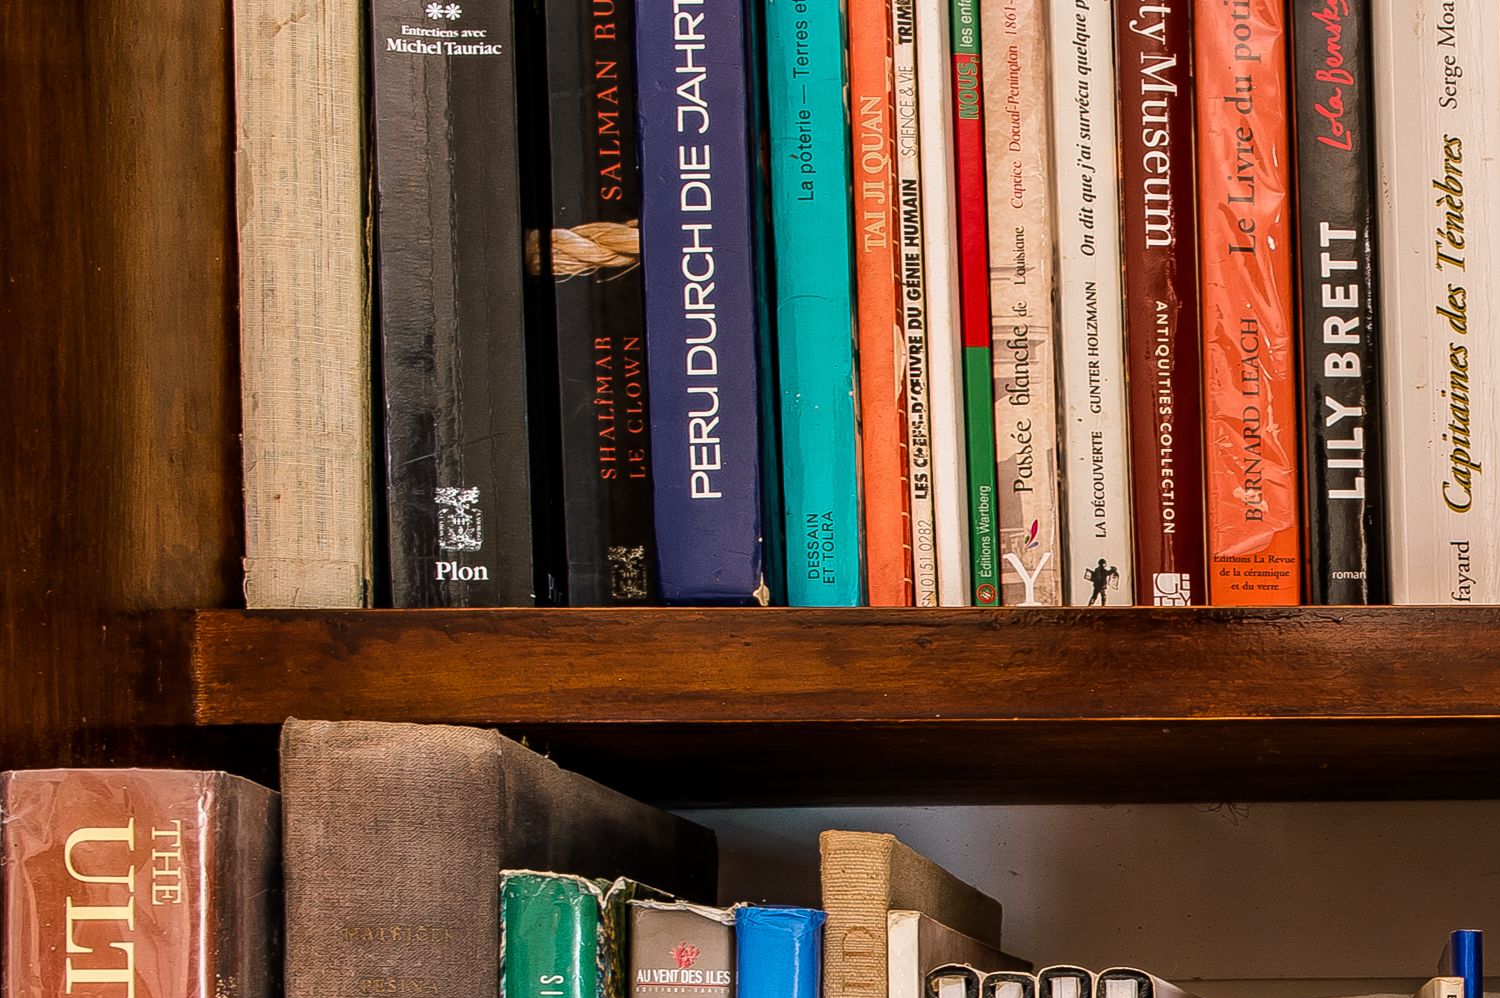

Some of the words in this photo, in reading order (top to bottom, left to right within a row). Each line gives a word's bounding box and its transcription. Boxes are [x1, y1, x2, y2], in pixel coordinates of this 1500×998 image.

[386, 38, 442, 55] Michel
[444, 41, 502, 56] Tauriac
[400, 25, 456, 38] Entretiens
[792, 19, 810, 79] Terres
[1438, 54, 1463, 110] Serge
[600, 58, 623, 201] SALMAN
[860, 95, 891, 174] QUAN
[1139, 51, 1178, 250] Museum
[1314, 88, 1353, 152] Lola
[679, 144, 713, 212] DIE
[1227, 126, 1256, 207] Livre
[863, 210, 888, 253] TAI
[901, 178, 921, 247] HUMAIN
[1432, 133, 1467, 273] Ténèbres
[1012, 225, 1027, 286] Louisiane
[681, 222, 718, 377] DURCH
[1083, 281, 1100, 357] HOLZMANN
[1319, 221, 1362, 378] BRETT
[1086, 358, 1102, 415] GUNTER
[1239, 317, 1261, 397] LEACH
[594, 335, 616, 480] SHALIMAR
[687, 386, 723, 499] PERU
[1440, 342, 1483, 514] Capitaines
[1011, 417, 1035, 494] Passée
[1088, 430, 1107, 519] DÉCOUVERTE
[1242, 405, 1264, 523] BERNARD
[1324, 395, 1366, 500] LILY
[806, 512, 819, 580] DESSAIN
[821, 510, 835, 560] TOLRA
[977, 485, 991, 535] Wartberg
[434, 561, 489, 582] Plon
[1243, 567, 1291, 580] céramique
[1332, 571, 1367, 580] roman
[1450, 539, 1477, 603] fayard
[150, 819, 182, 906] THE
